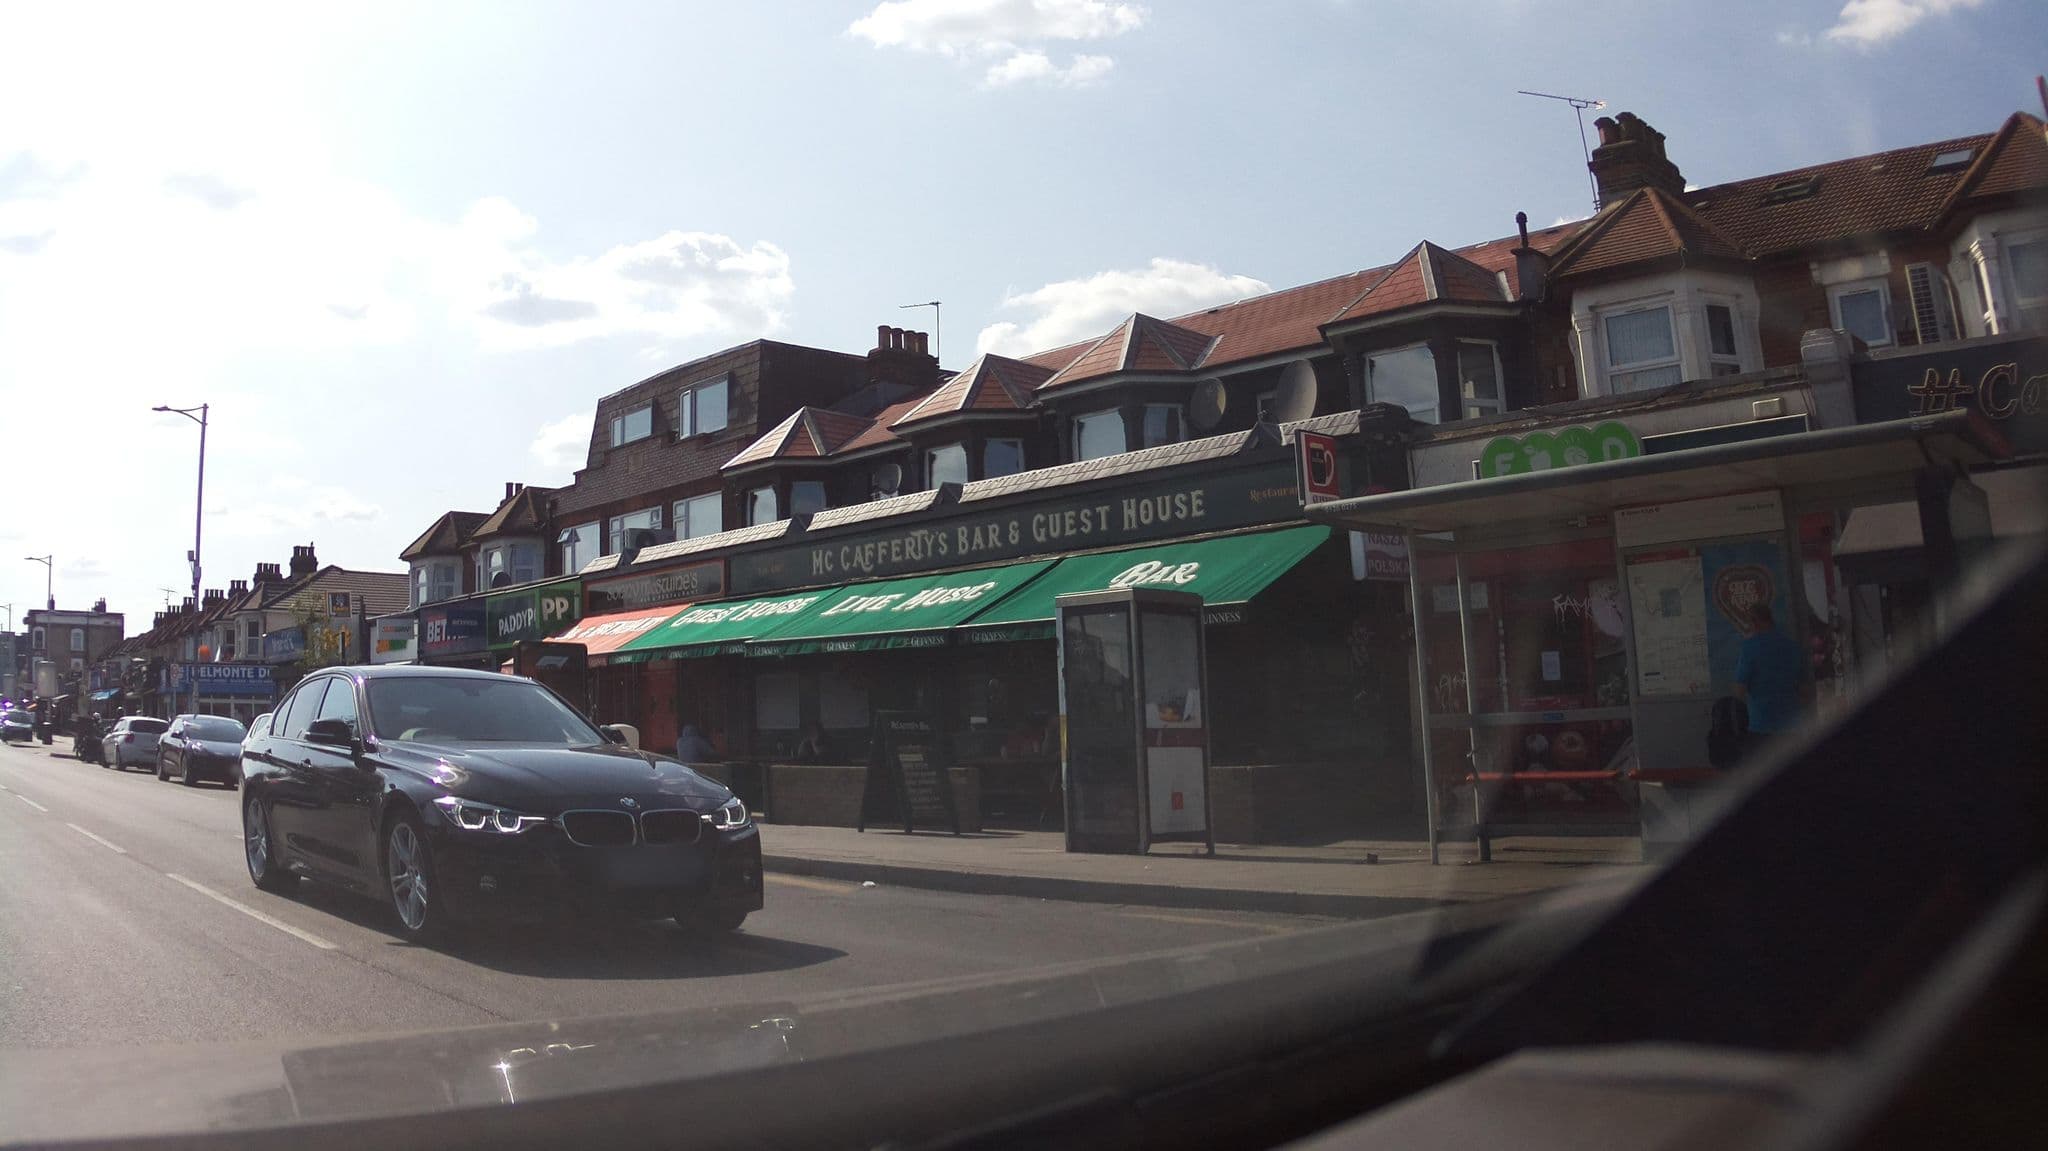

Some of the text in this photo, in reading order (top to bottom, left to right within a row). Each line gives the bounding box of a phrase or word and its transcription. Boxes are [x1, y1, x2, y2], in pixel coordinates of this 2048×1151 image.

[957, 523, 1000, 556] BAR
[1008, 520, 1020, 545] &
[1032, 505, 1110, 543] GUEST
[1122, 489, 1205, 531] HOUSE
[1108, 560, 1200, 589] BAR
[541, 597, 569, 622] PP
[670, 603, 749, 628] GUEST
[728, 596, 820, 622] HOUSE
[820, 581, 998, 618] LIVE MUSIC
